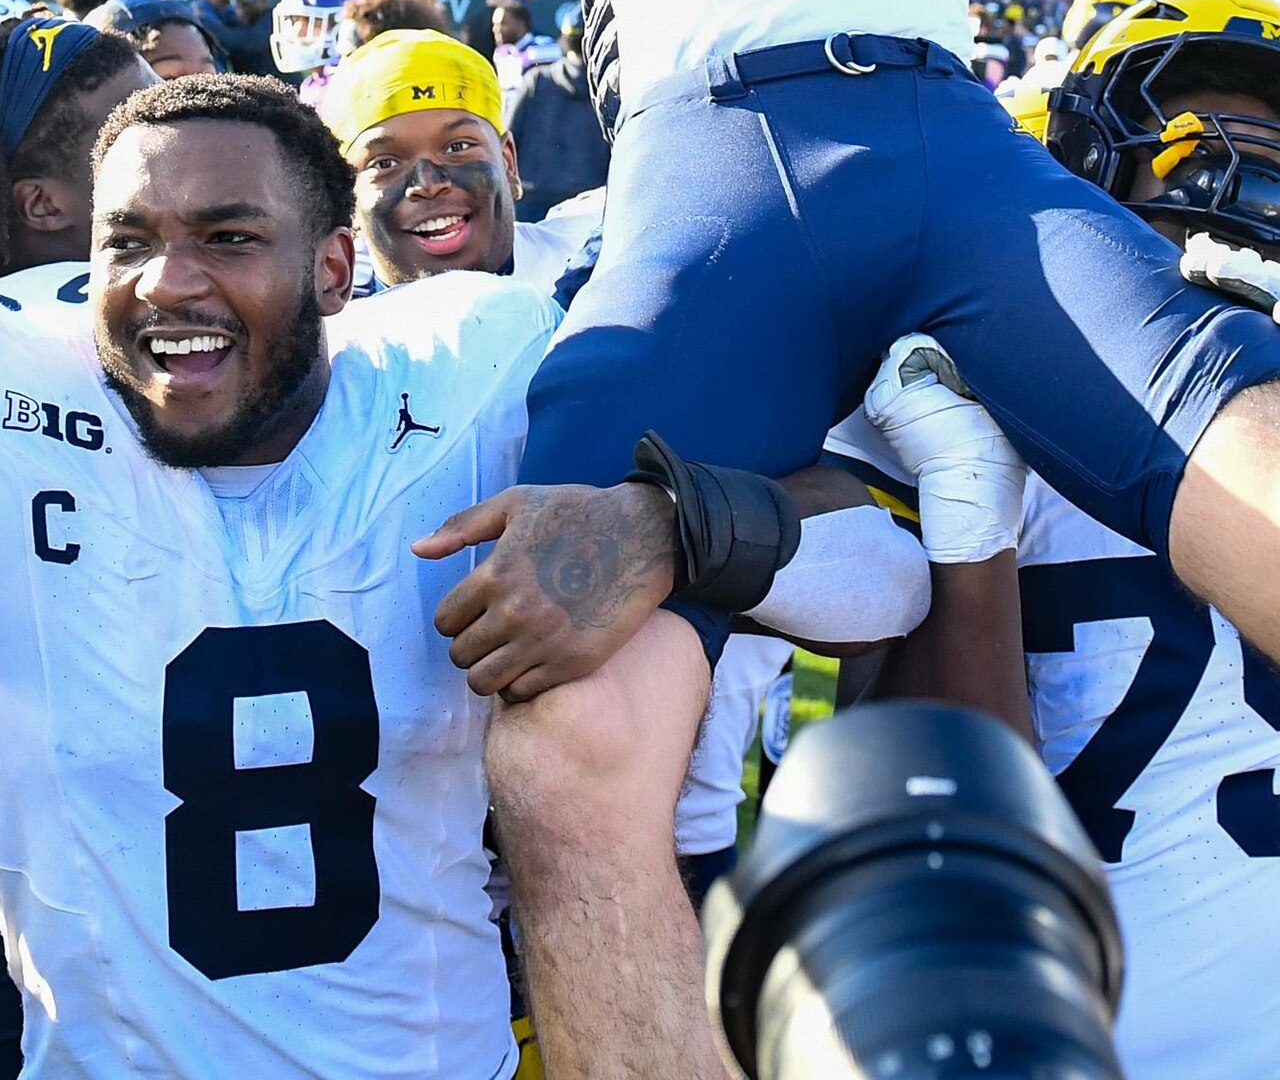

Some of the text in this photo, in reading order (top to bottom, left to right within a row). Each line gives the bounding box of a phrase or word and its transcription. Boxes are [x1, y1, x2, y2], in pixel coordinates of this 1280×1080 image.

[411, 86, 436, 100] M
[32, 490, 81, 565] C
[162, 618, 381, 982] 8
